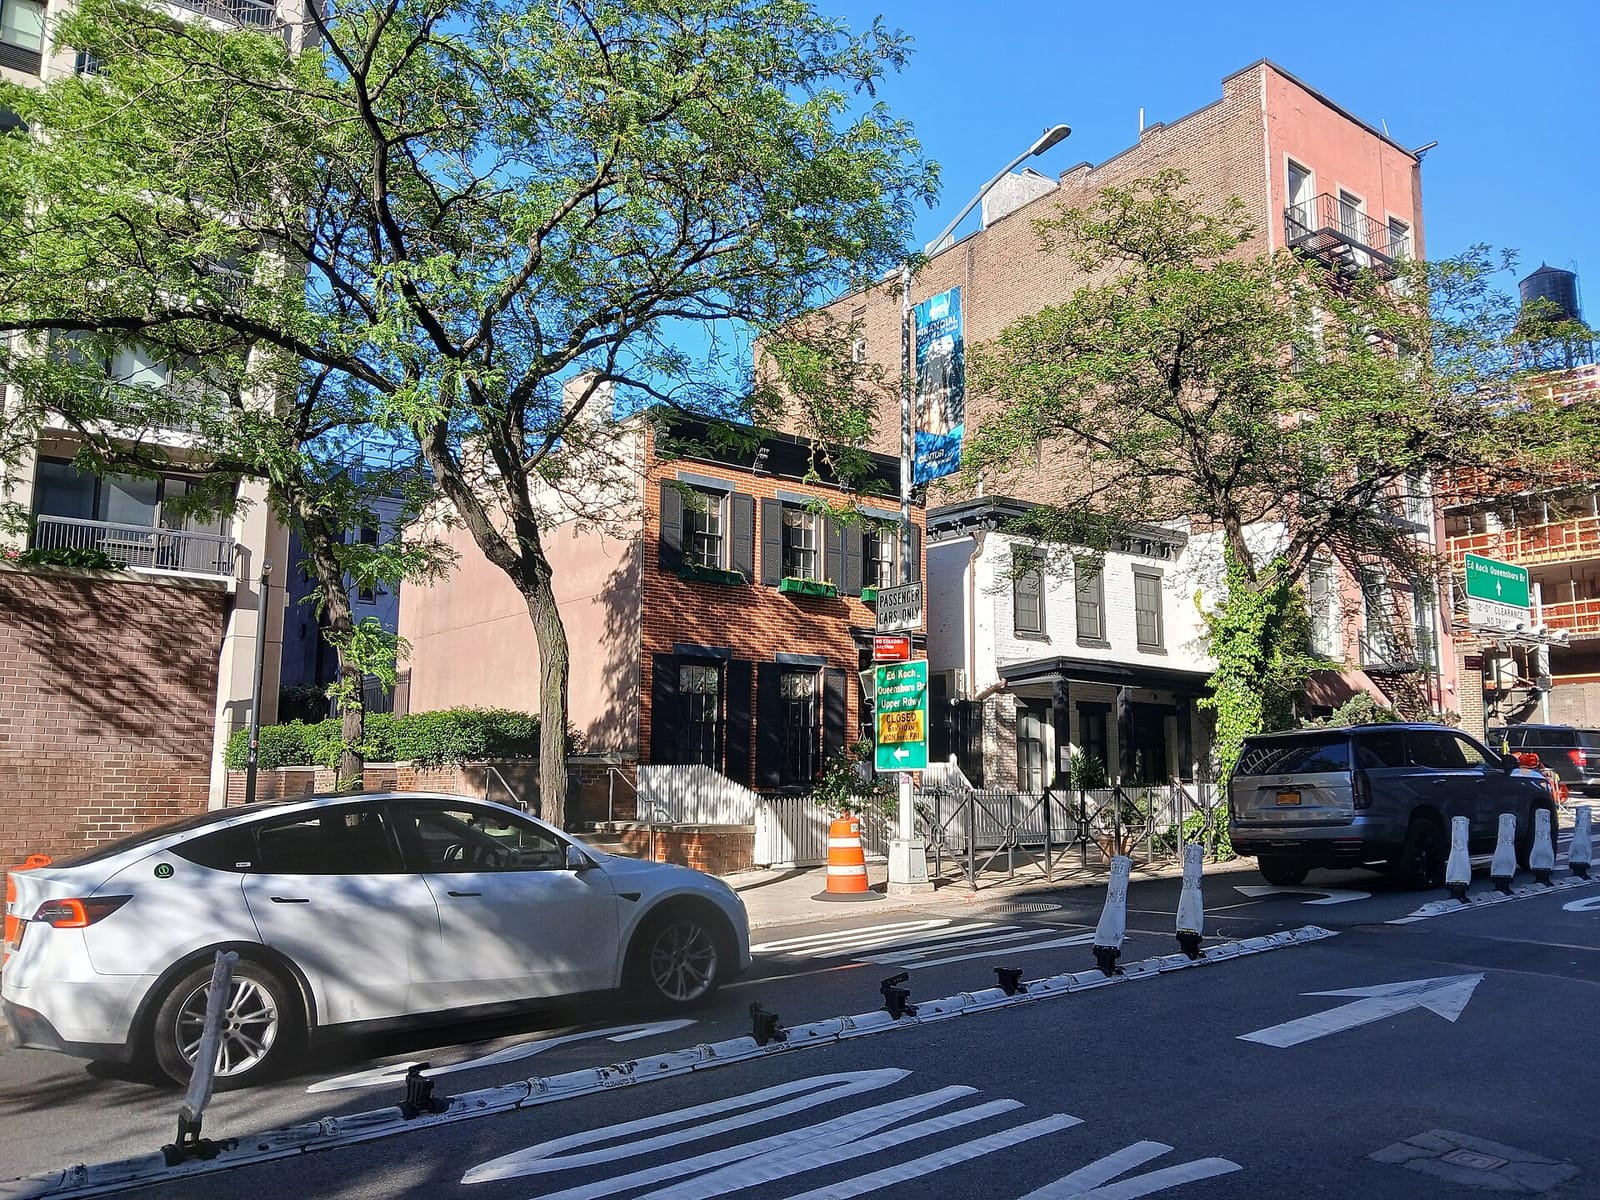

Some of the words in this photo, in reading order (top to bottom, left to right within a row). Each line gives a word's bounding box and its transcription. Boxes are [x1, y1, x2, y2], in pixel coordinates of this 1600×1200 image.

[916, 315, 959, 337] FINANCIAL
[1467, 560, 1474, 569] Ed
[1476, 562, 1489, 573] Koch
[1490, 566, 1519, 581] Queensboro
[1520, 573, 1526, 582] Br
[880, 589, 920, 608] PASSENGER
[879, 610, 898, 625] CARS
[902, 606, 920, 622] ONLY
[1495, 606, 1524, 620] CLEARANCE
[1486, 616, 1495, 625] NO
[886, 671, 896, 681] Ed
[898, 668, 916, 679] Koch
[878, 683, 915, 695] Queensboro
[916, 682, 925, 691] Br
[881, 699, 901, 710] Upper
[902, 697, 922, 708] Rdwy
[886, 712, 917, 723] CLOSED
[883, 734, 897, 742] MON
